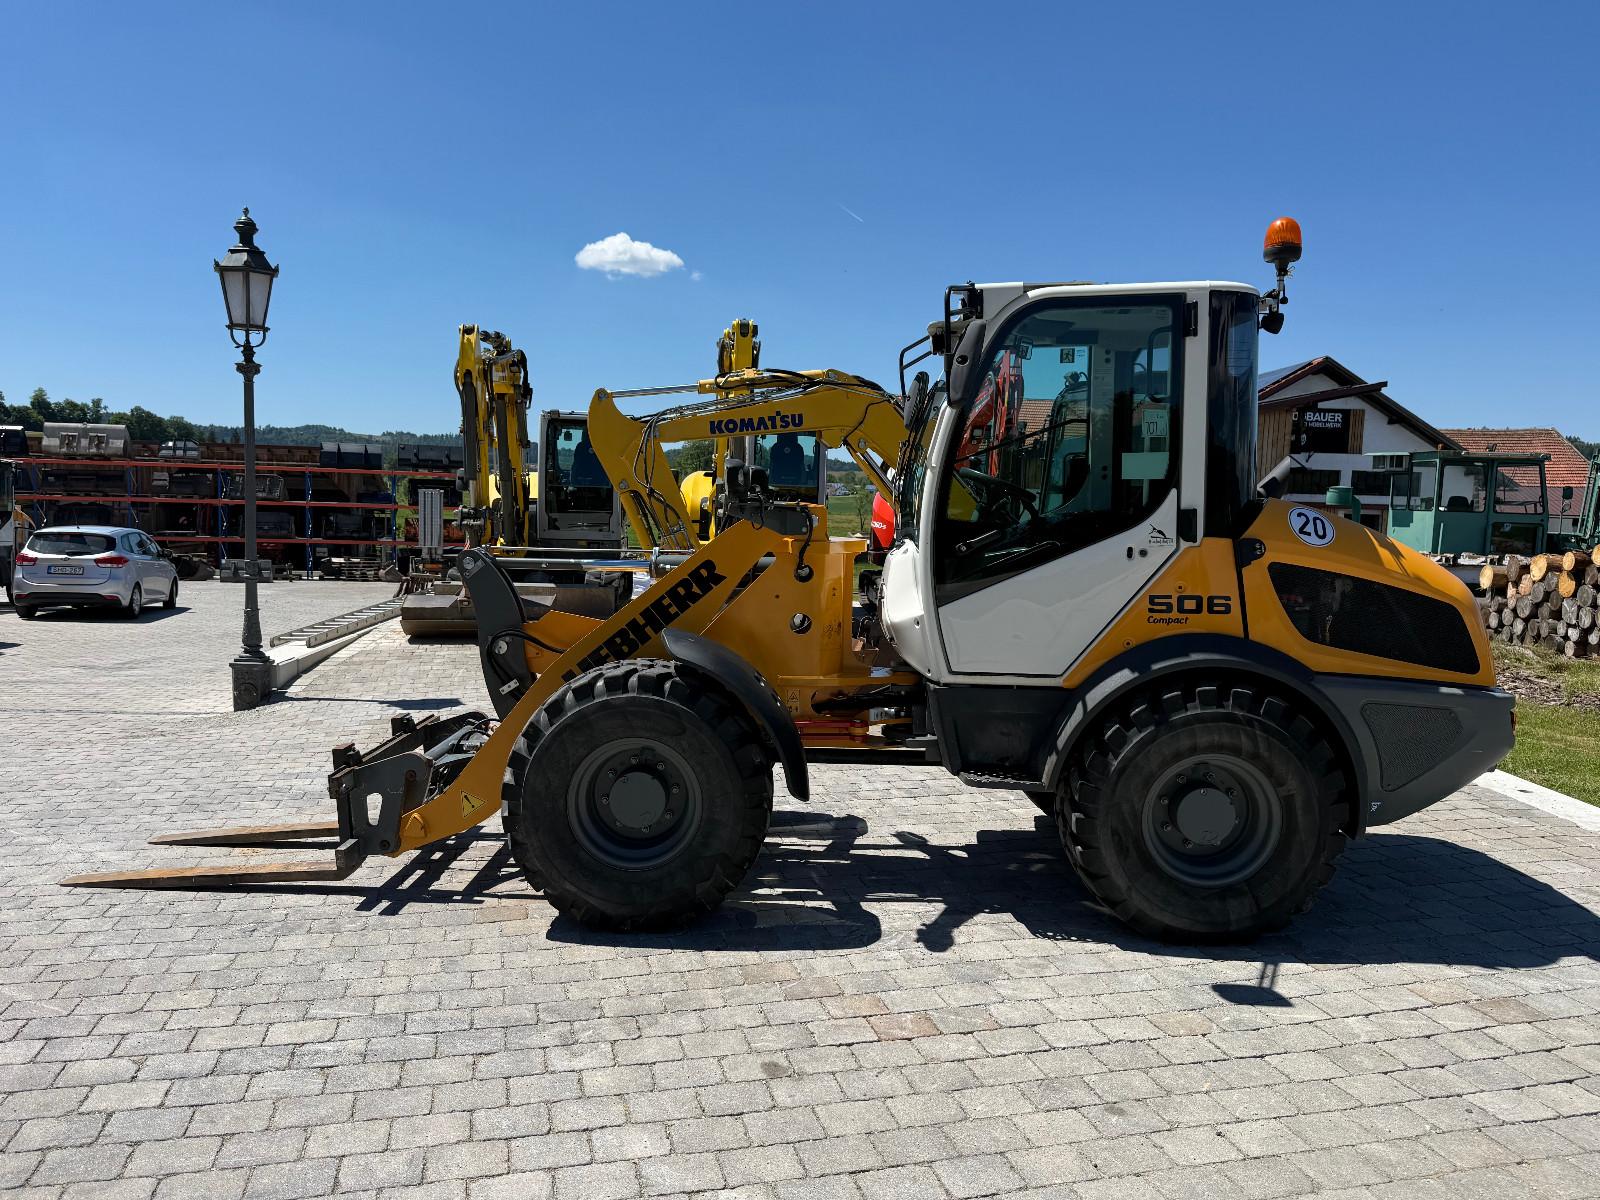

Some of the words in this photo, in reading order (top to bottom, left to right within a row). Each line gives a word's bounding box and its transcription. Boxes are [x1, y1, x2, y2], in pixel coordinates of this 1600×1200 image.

[709, 411, 804, 434] KOMATSU
[1296, 512, 1327, 540] 20
[1147, 594, 1232, 615] 506
[1147, 615, 1189, 626] Compact
